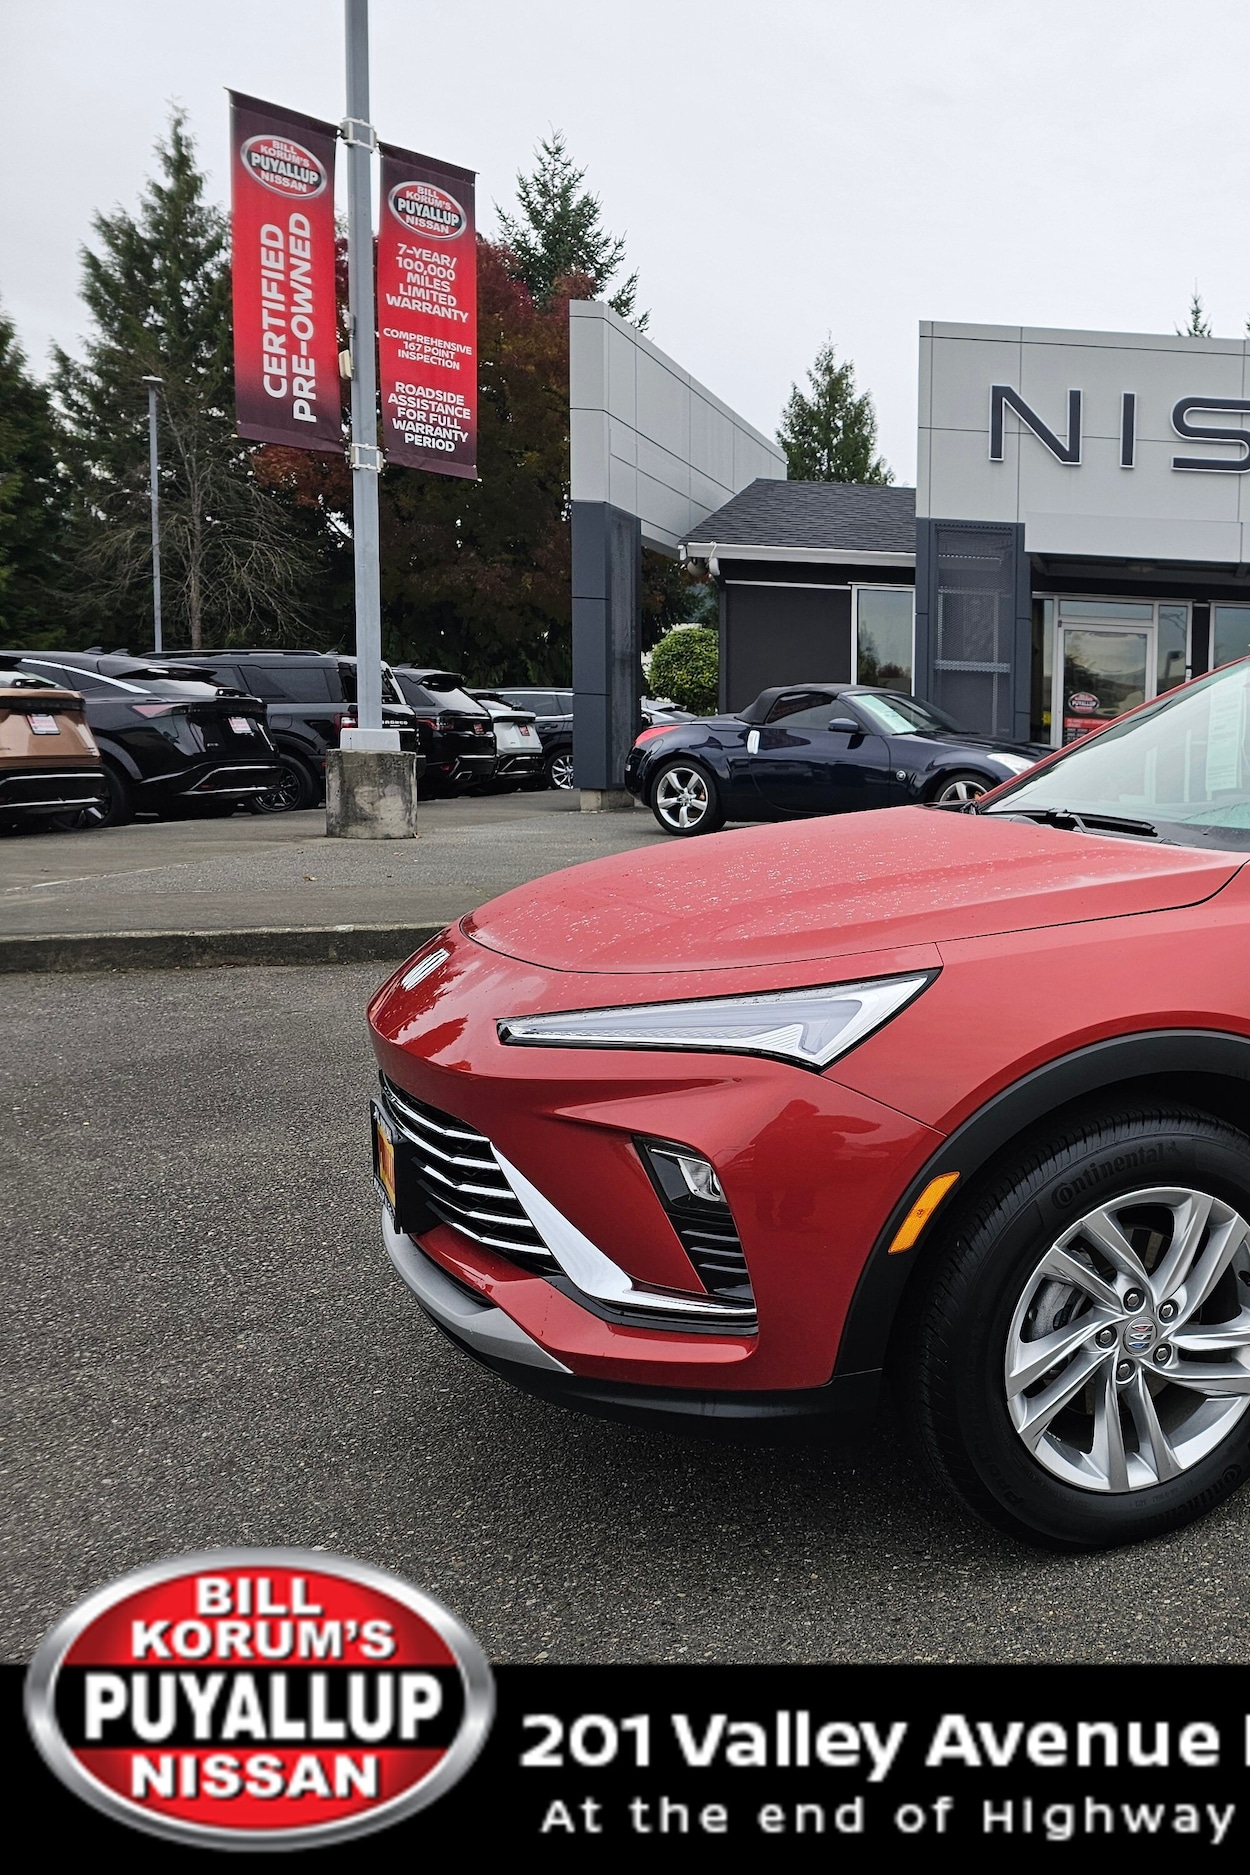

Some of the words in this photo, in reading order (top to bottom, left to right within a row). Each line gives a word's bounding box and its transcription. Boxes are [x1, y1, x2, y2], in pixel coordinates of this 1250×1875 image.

[260, 144, 310, 168] KORUM'S
[272, 140, 297, 155] BILL
[251, 152, 319, 185] PUYALLUP
[261, 170, 307, 193] NISSAN
[417, 186, 439, 200] BILL
[397, 198, 460, 226] PUYALLUP
[405, 190, 452, 210] KORUM'S
[405, 214, 449, 234] NISSAN
[397, 243, 457, 269] 7-YEAR/
[395, 256, 456, 281] 100,000
[406, 272, 451, 292] MILES
[399, 283, 457, 307] LIMITED
[260, 223, 288, 399] CERTIFIED
[288, 212, 317, 423] PRE-OWNED
[386, 293, 469, 323] WARRANTY
[383, 327, 473, 355] COMPREHENSIVE
[403, 341, 422, 352] 167
[424, 345, 455, 360] POINT
[397, 349, 461, 370] INSPECTION
[395, 381, 465, 406] ROADSIDE
[388, 393, 471, 419] ASSISTANCE
[397, 406, 427, 423] FOR
[429, 412, 461, 430] FULL
[392, 418, 469, 443] WARRANTY
[404, 432, 456, 453] PERIOD
[1051, 1142, 1164, 1210] Continental
